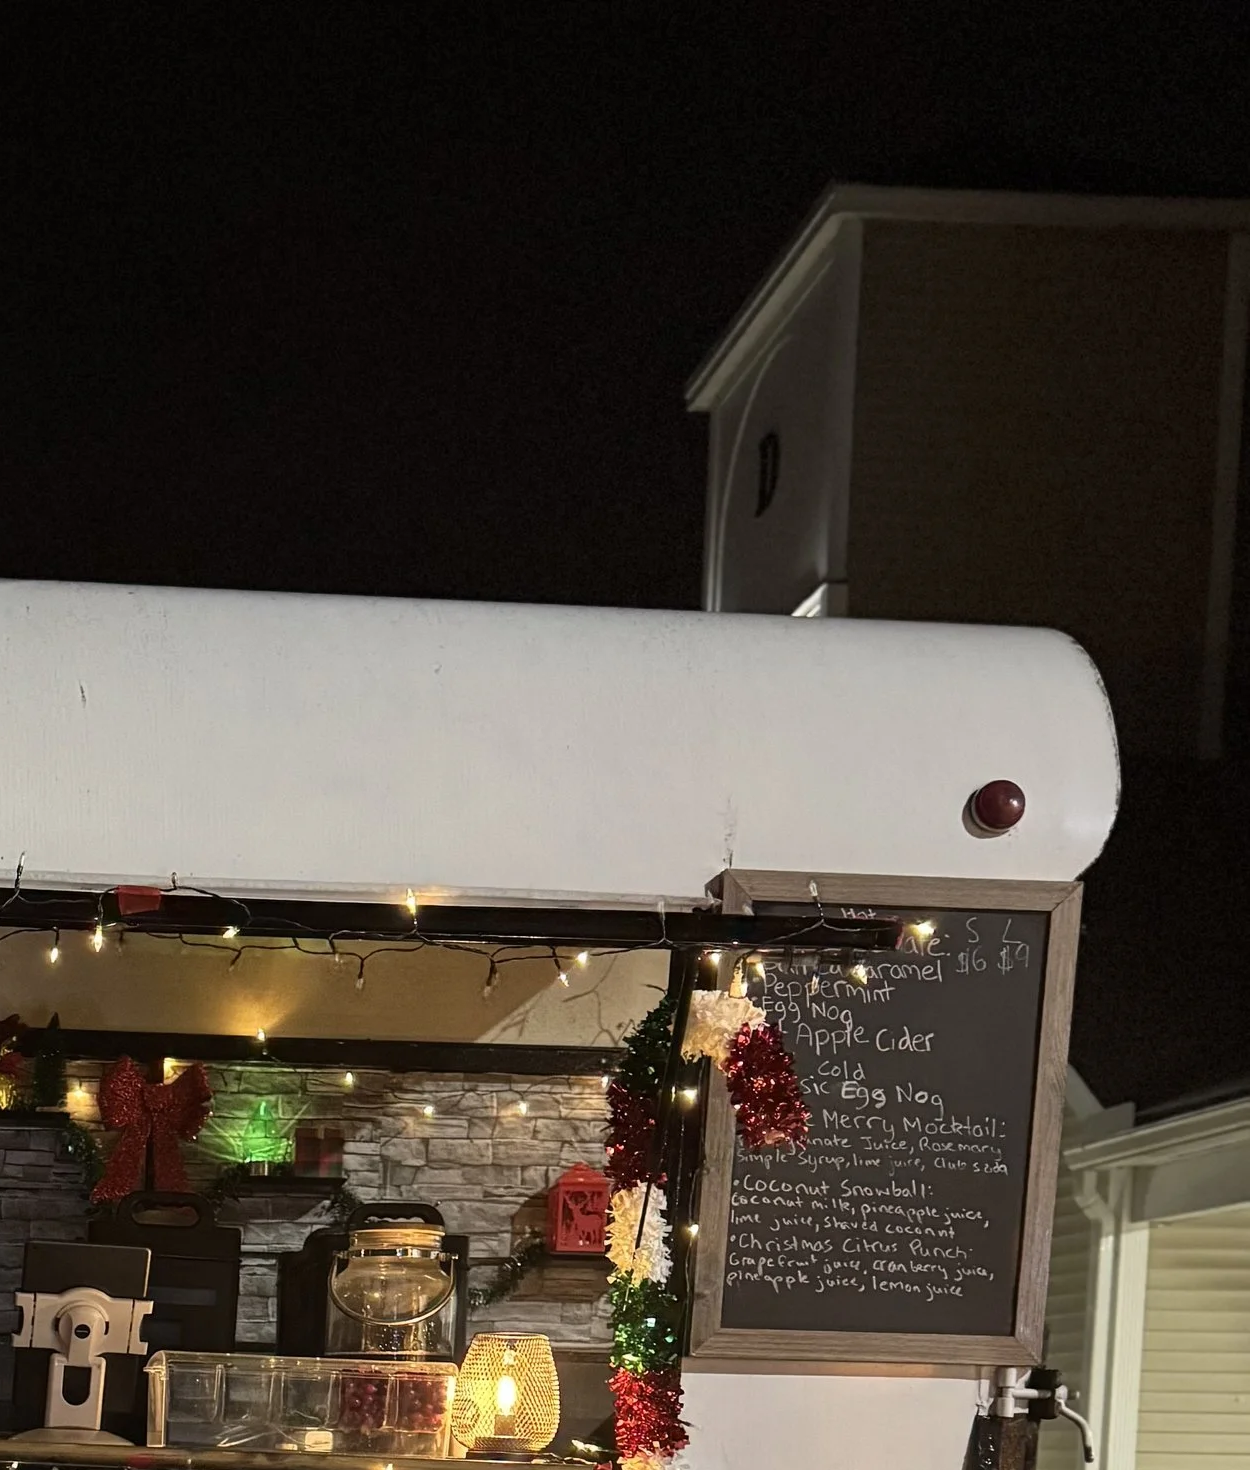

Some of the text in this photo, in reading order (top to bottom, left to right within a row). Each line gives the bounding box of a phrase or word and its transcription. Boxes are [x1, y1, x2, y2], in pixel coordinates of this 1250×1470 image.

[965, 917, 1024, 944] S L
[862, 959, 943, 983] aramel
[956, 942, 1031, 975] $6 $9
[763, 972, 897, 1008] Peppermint
[762, 996, 802, 1024] Egg
[811, 1001, 853, 1028] Nog
[795, 1022, 870, 1056] Apple
[876, 1026, 936, 1052] Cider
[841, 1080, 887, 1110] Egg
[896, 1082, 945, 1121] Nog
[822, 1109, 896, 1143] Merry
[902, 1115, 1007, 1139] Mocktail:
[918, 1136, 1003, 1162] Rosemary
[852, 1153, 882, 1168] lime
[888, 1156, 926, 1177] juice,
[743, 1174, 934, 1199] Coconut Snowball:
[730, 1209, 762, 1225] lime
[769, 1213, 820, 1233] juice,
[811, 1197, 857, 1216] milk,
[860, 1201, 941, 1225] pineapple
[943, 1207, 990, 1229] juice,
[738, 1233, 833, 1254] Christmas
[842, 1237, 898, 1253] Citrus
[729, 1252, 818, 1277] Grapefruit
[872, 1259, 949, 1281] cranberry
[953, 1261, 995, 1282] juice,
[814, 1275, 866, 1293] juice,
[872, 1275, 922, 1294] lemon
[925, 1283, 964, 1302] juice
